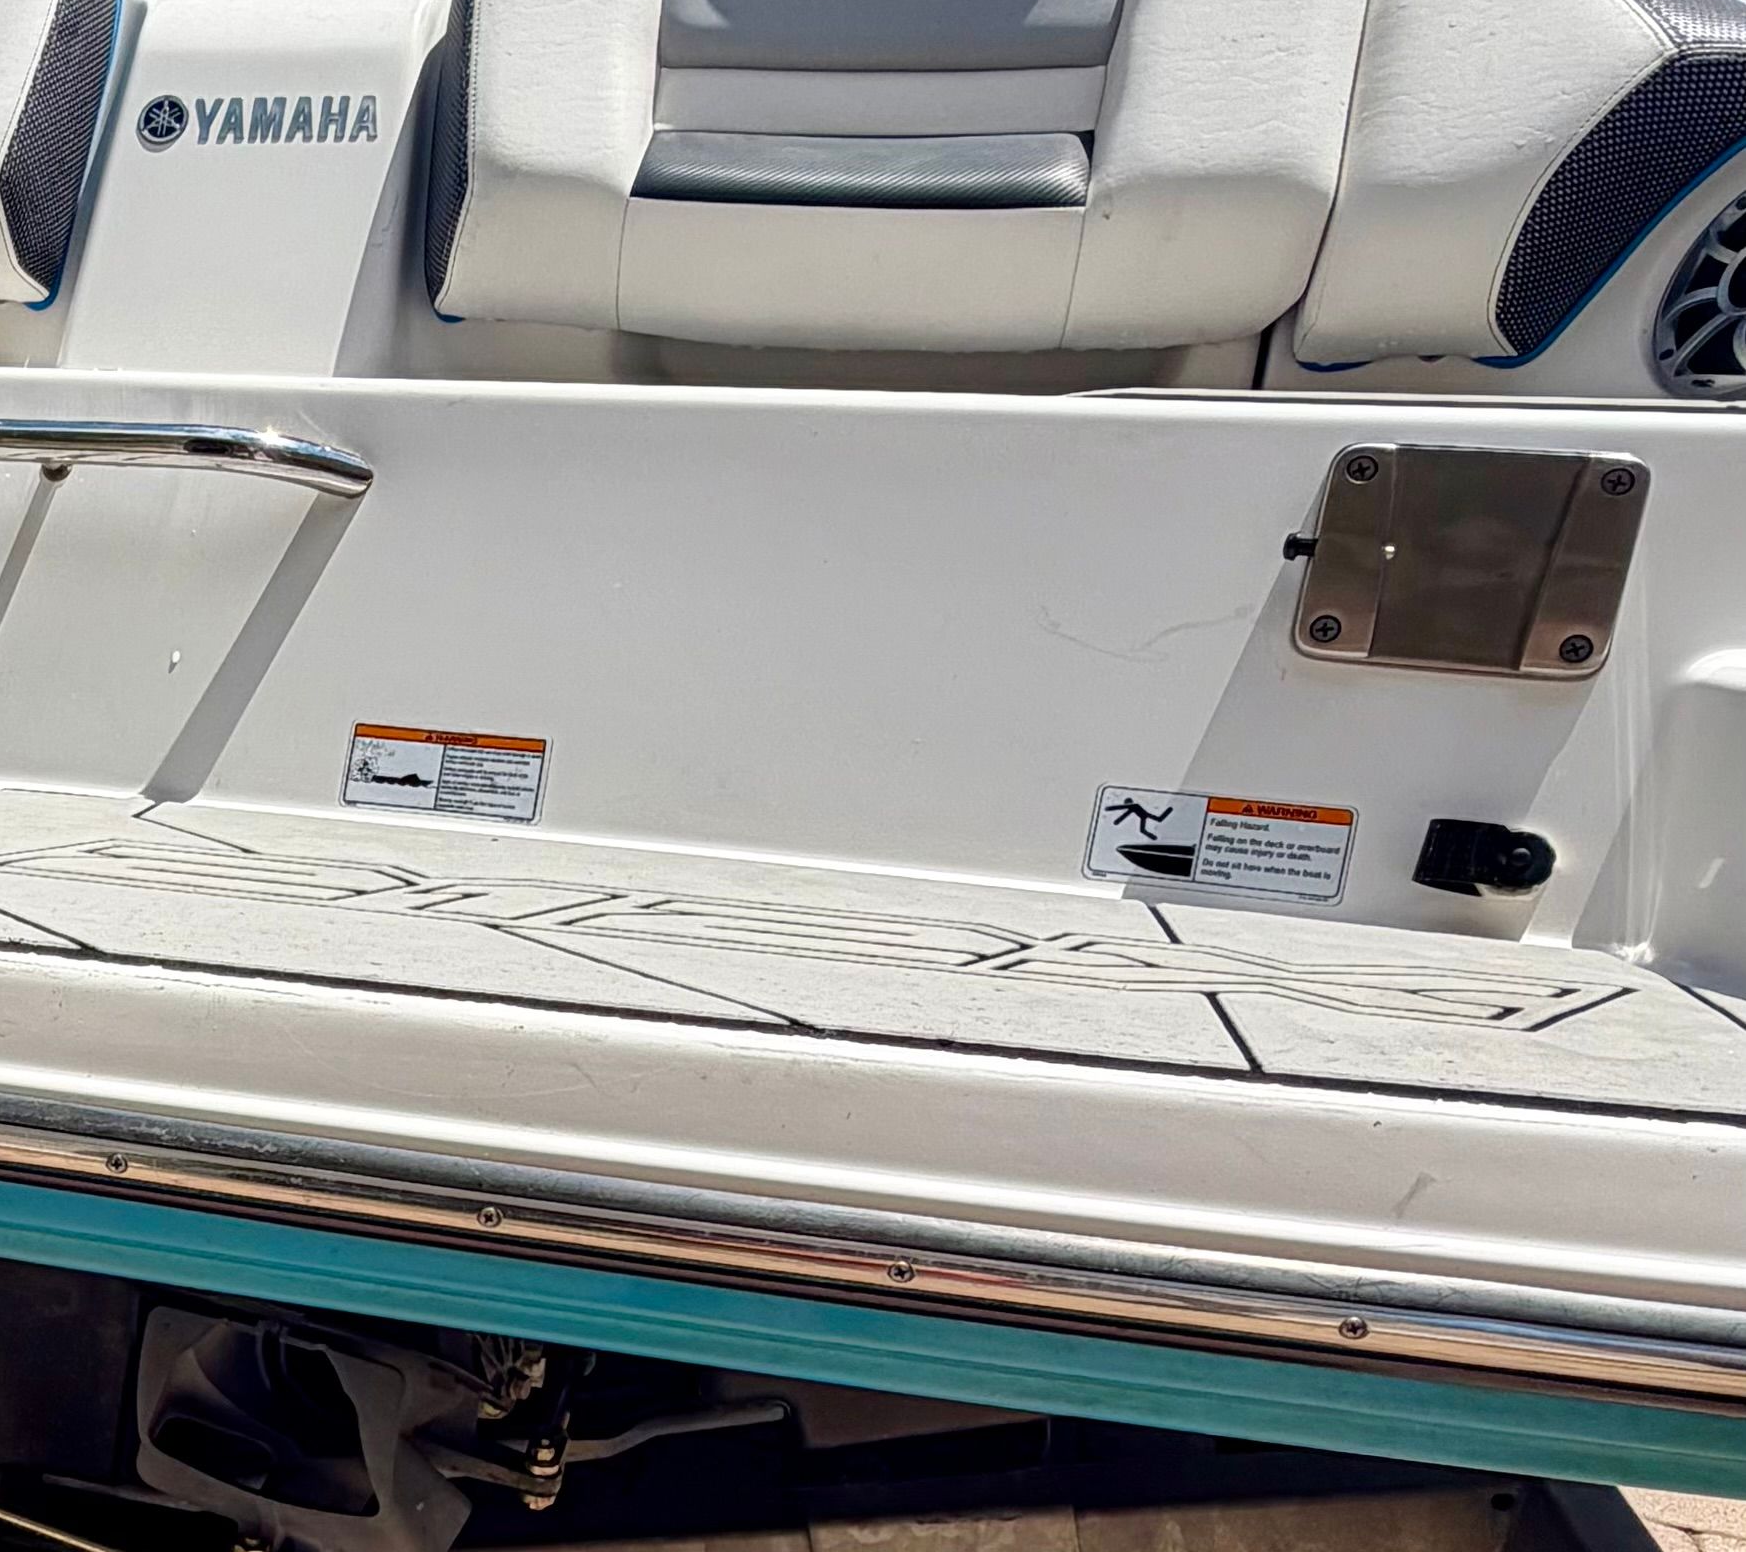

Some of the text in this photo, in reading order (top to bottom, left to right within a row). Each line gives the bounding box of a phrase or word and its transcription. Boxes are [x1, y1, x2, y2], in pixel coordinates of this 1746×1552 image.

[195, 95, 377, 145] YAMAHA
[1257, 805, 1318, 819] WARNING
[1207, 833, 1234, 845] Falling
